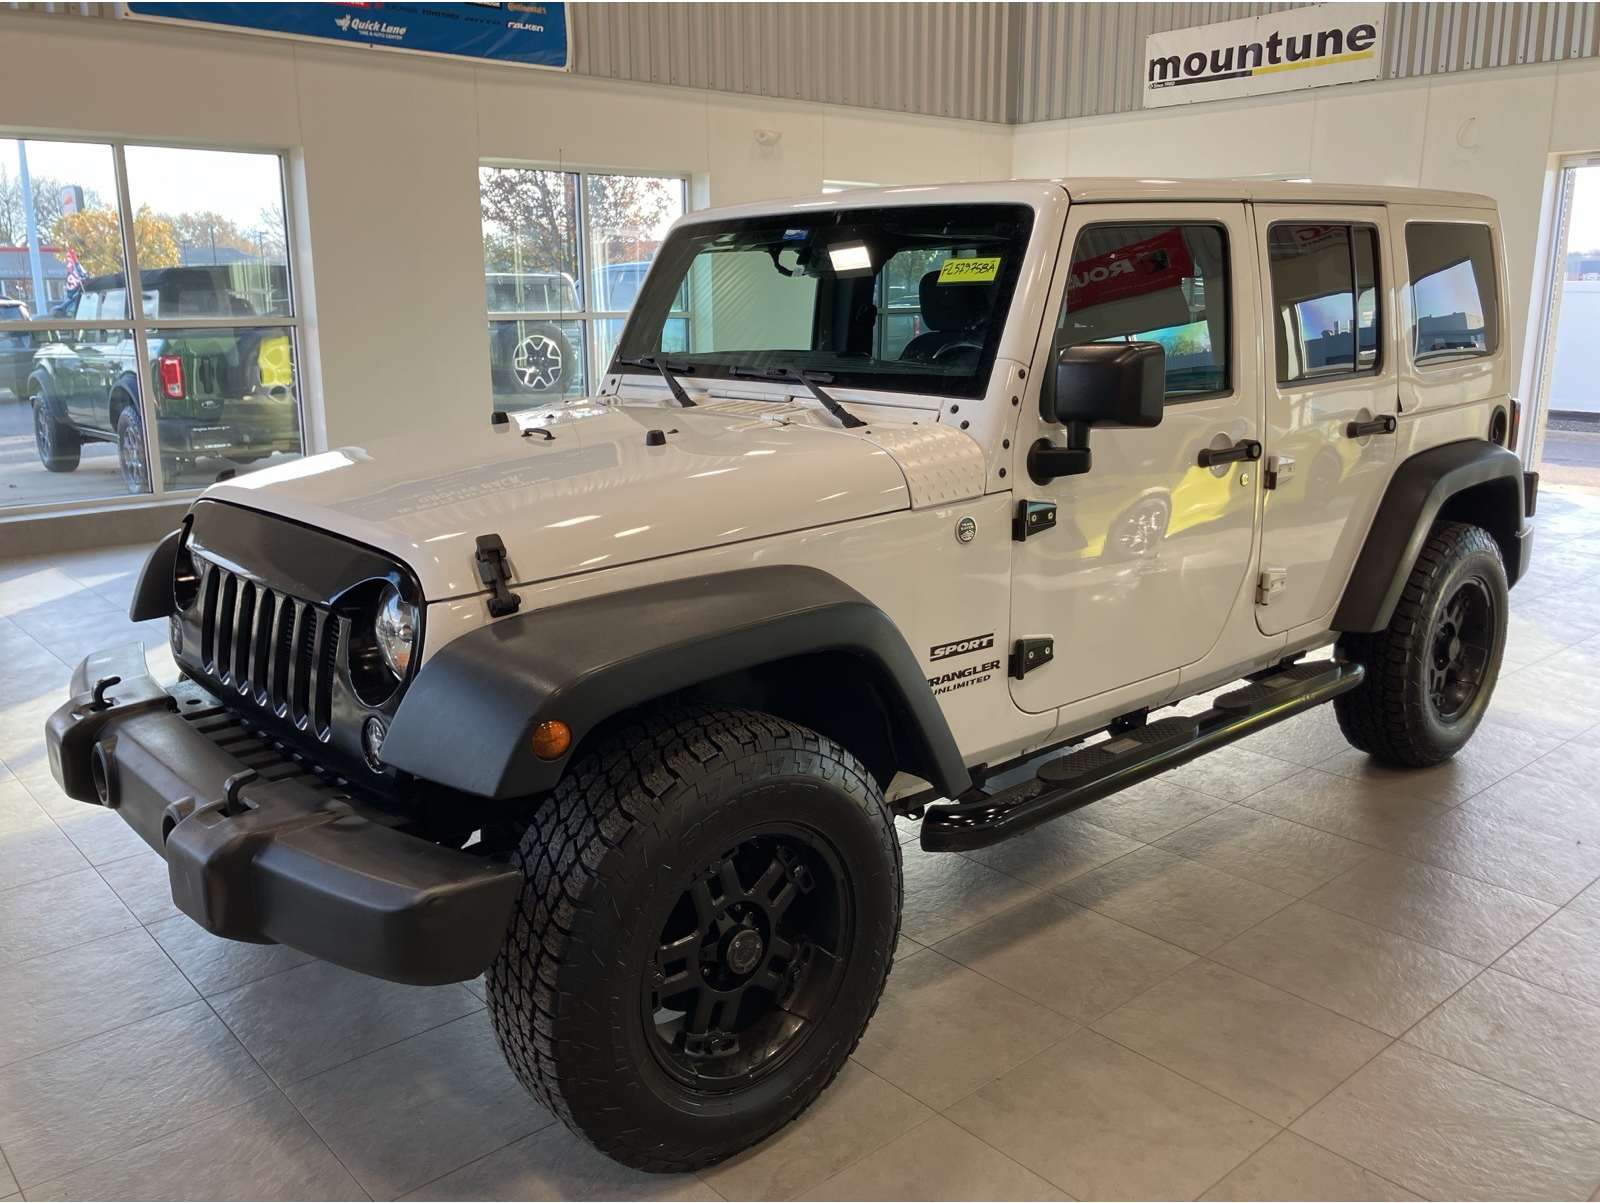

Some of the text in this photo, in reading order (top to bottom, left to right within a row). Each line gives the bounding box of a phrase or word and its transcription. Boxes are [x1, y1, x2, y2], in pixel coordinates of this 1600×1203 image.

[351, 18, 407, 35] Quick Lane
[507, 21, 544, 32] FALKEN
[1148, 23, 1376, 82] mountune
[931, 635, 994, 659] SPORT
[928, 659, 1001, 687] RANGLER
